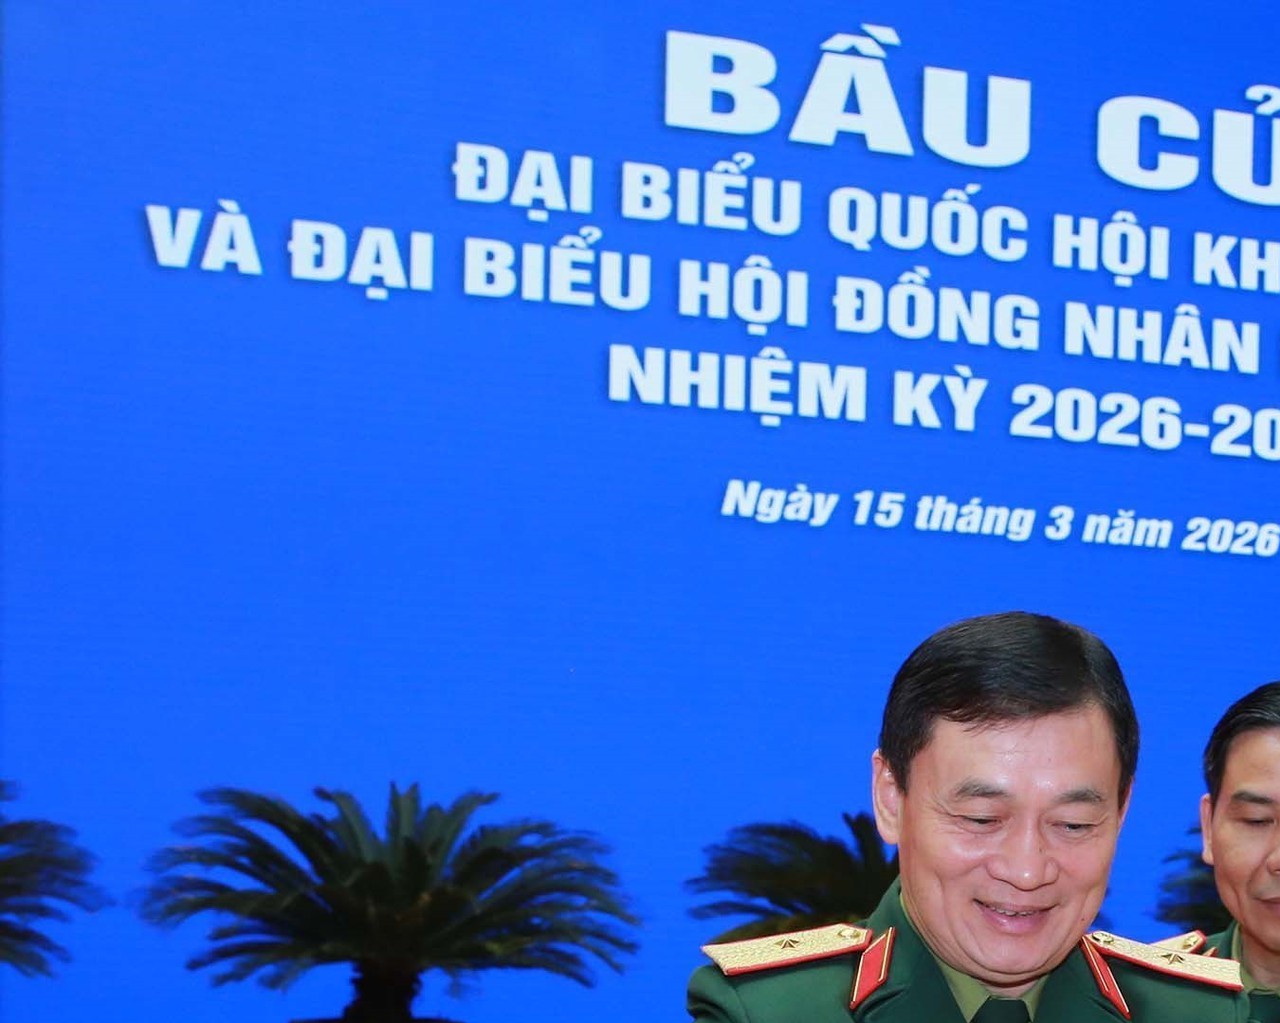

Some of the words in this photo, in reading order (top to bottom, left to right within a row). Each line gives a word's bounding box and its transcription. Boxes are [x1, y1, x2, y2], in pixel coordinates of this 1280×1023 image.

[664, 23, 1031, 167] BẦU
[145, 199, 262, 275] VÀ
[287, 219, 434, 301] ĐẠI
[464, 226, 651, 310] BIỂU
[678, 255, 808, 336] HỘI
[832, 265, 1040, 350] ĐỒNG
[1064, 302, 1260, 374] NHÂN
[451, 141, 593, 222] ĐẠI
[621, 151, 802, 235] BIỂU
[828, 184, 1028, 261] QUỐC
[1053, 210, 1170, 288] HỘI
[608, 343, 867, 427] NHIỆM
[893, 366, 989, 431] KỲ
[721, 479, 839, 527] Ngày
[853, 490, 906, 528] 15
[914, 494, 1036, 542] tháng
[1044, 505, 1075, 540] 3
[1082, 514, 1173, 548] năm
